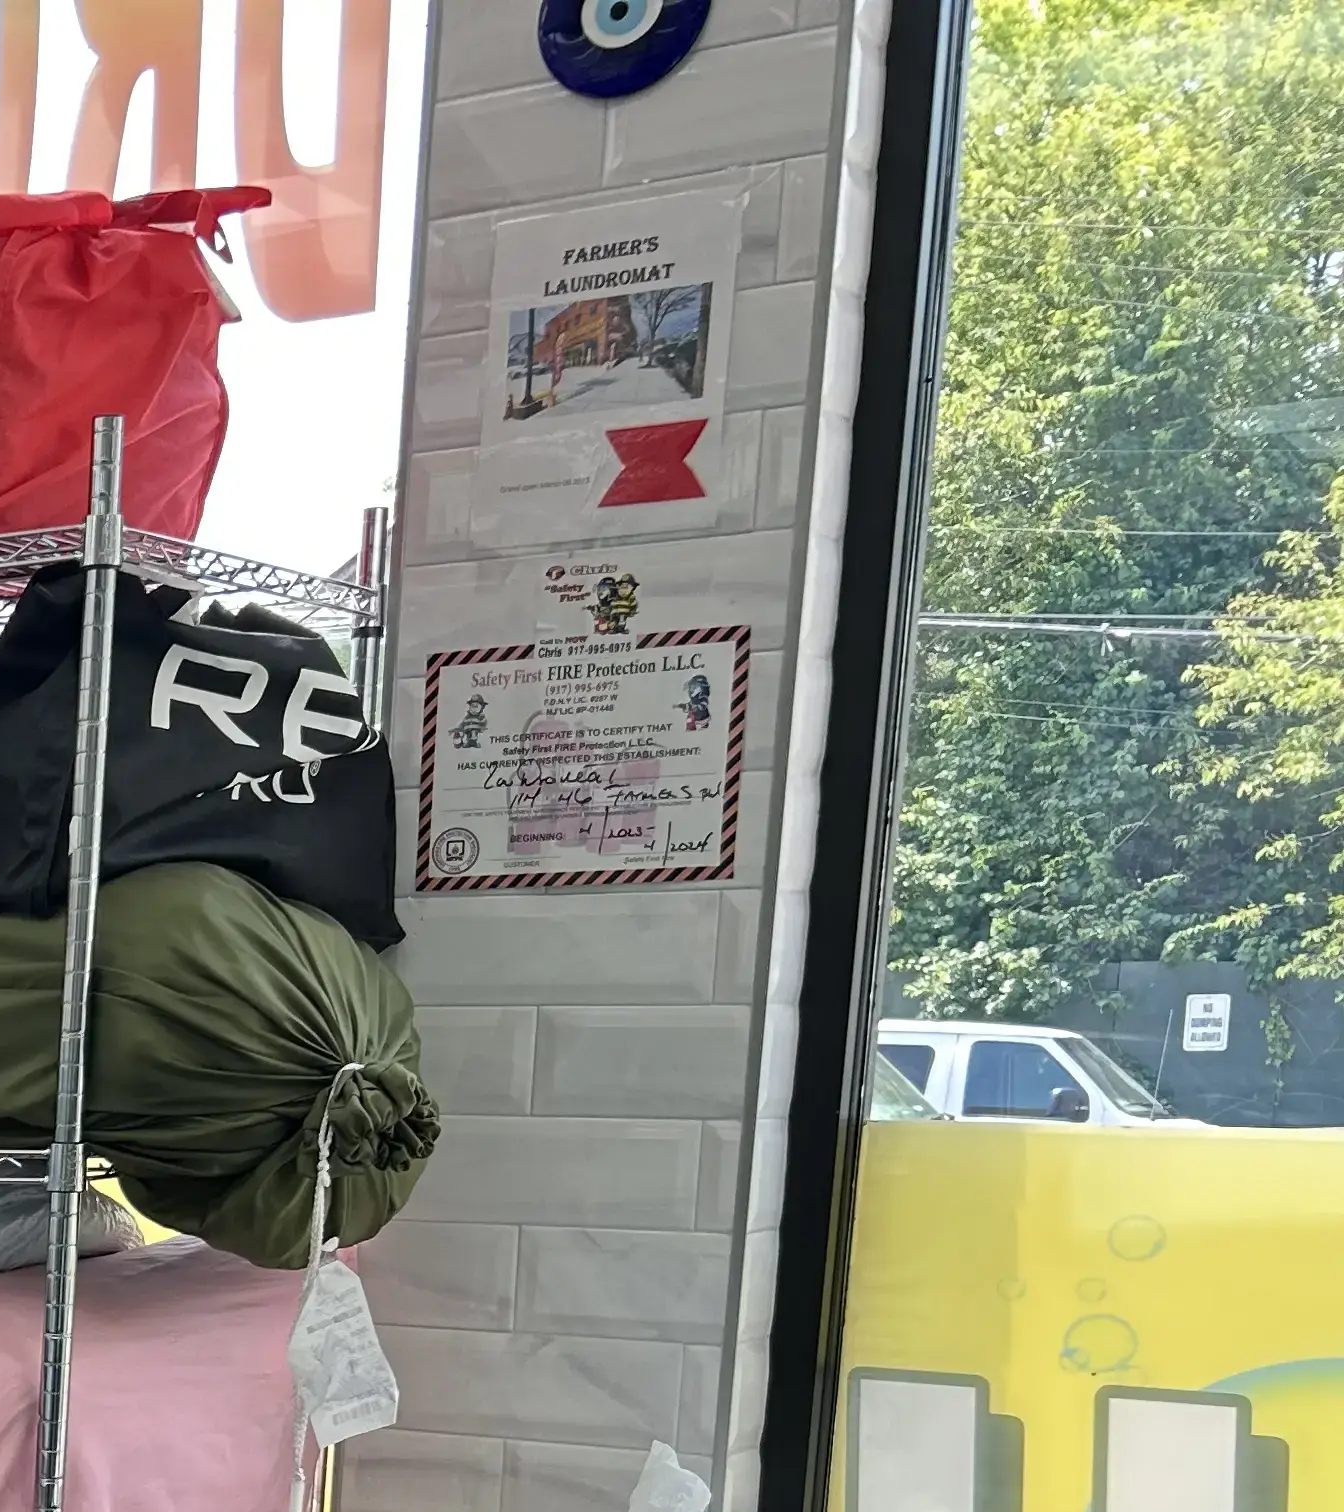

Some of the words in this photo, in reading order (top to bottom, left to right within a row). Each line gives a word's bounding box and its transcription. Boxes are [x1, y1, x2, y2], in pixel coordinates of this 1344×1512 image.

[562, 236, 660, 266] FARMER'S
[543, 262, 676, 298] LAUNDROMAT
[564, 635, 588, 645] NOW
[538, 646, 562, 659] Chris
[567, 642, 632, 657] 917-995-6975
[471, 672, 512, 690] Safety
[513, 669, 545, 686] First
[547, 664, 583, 682] FIRE
[586, 659, 656, 679] Protection
[661, 653, 706, 673] L.L.C.
[545, 683, 572, 697] (917)
[574, 681, 620, 694] 995-6975
[490, 734, 511, 744] THIS
[512, 730, 574, 743] CERTIFICATE
[575, 729, 586, 738] IS
[587, 728, 602, 738] TO
[603, 725, 645, 737] CERTIFY
[647, 723, 672, 733] THAT
[502, 745, 530, 758] Safety
[532, 744, 553, 755] First
[555, 742, 577, 753] FIRE
[578, 739, 627, 751] Protection
[457, 761, 477, 772] HAS
[536, 754, 592, 768] INSPECTED
[593, 751, 616, 763] THIS
[617, 747, 702, 762] ESTABLISHMENT:
[509, 831, 566, 845] BEGINNING:
